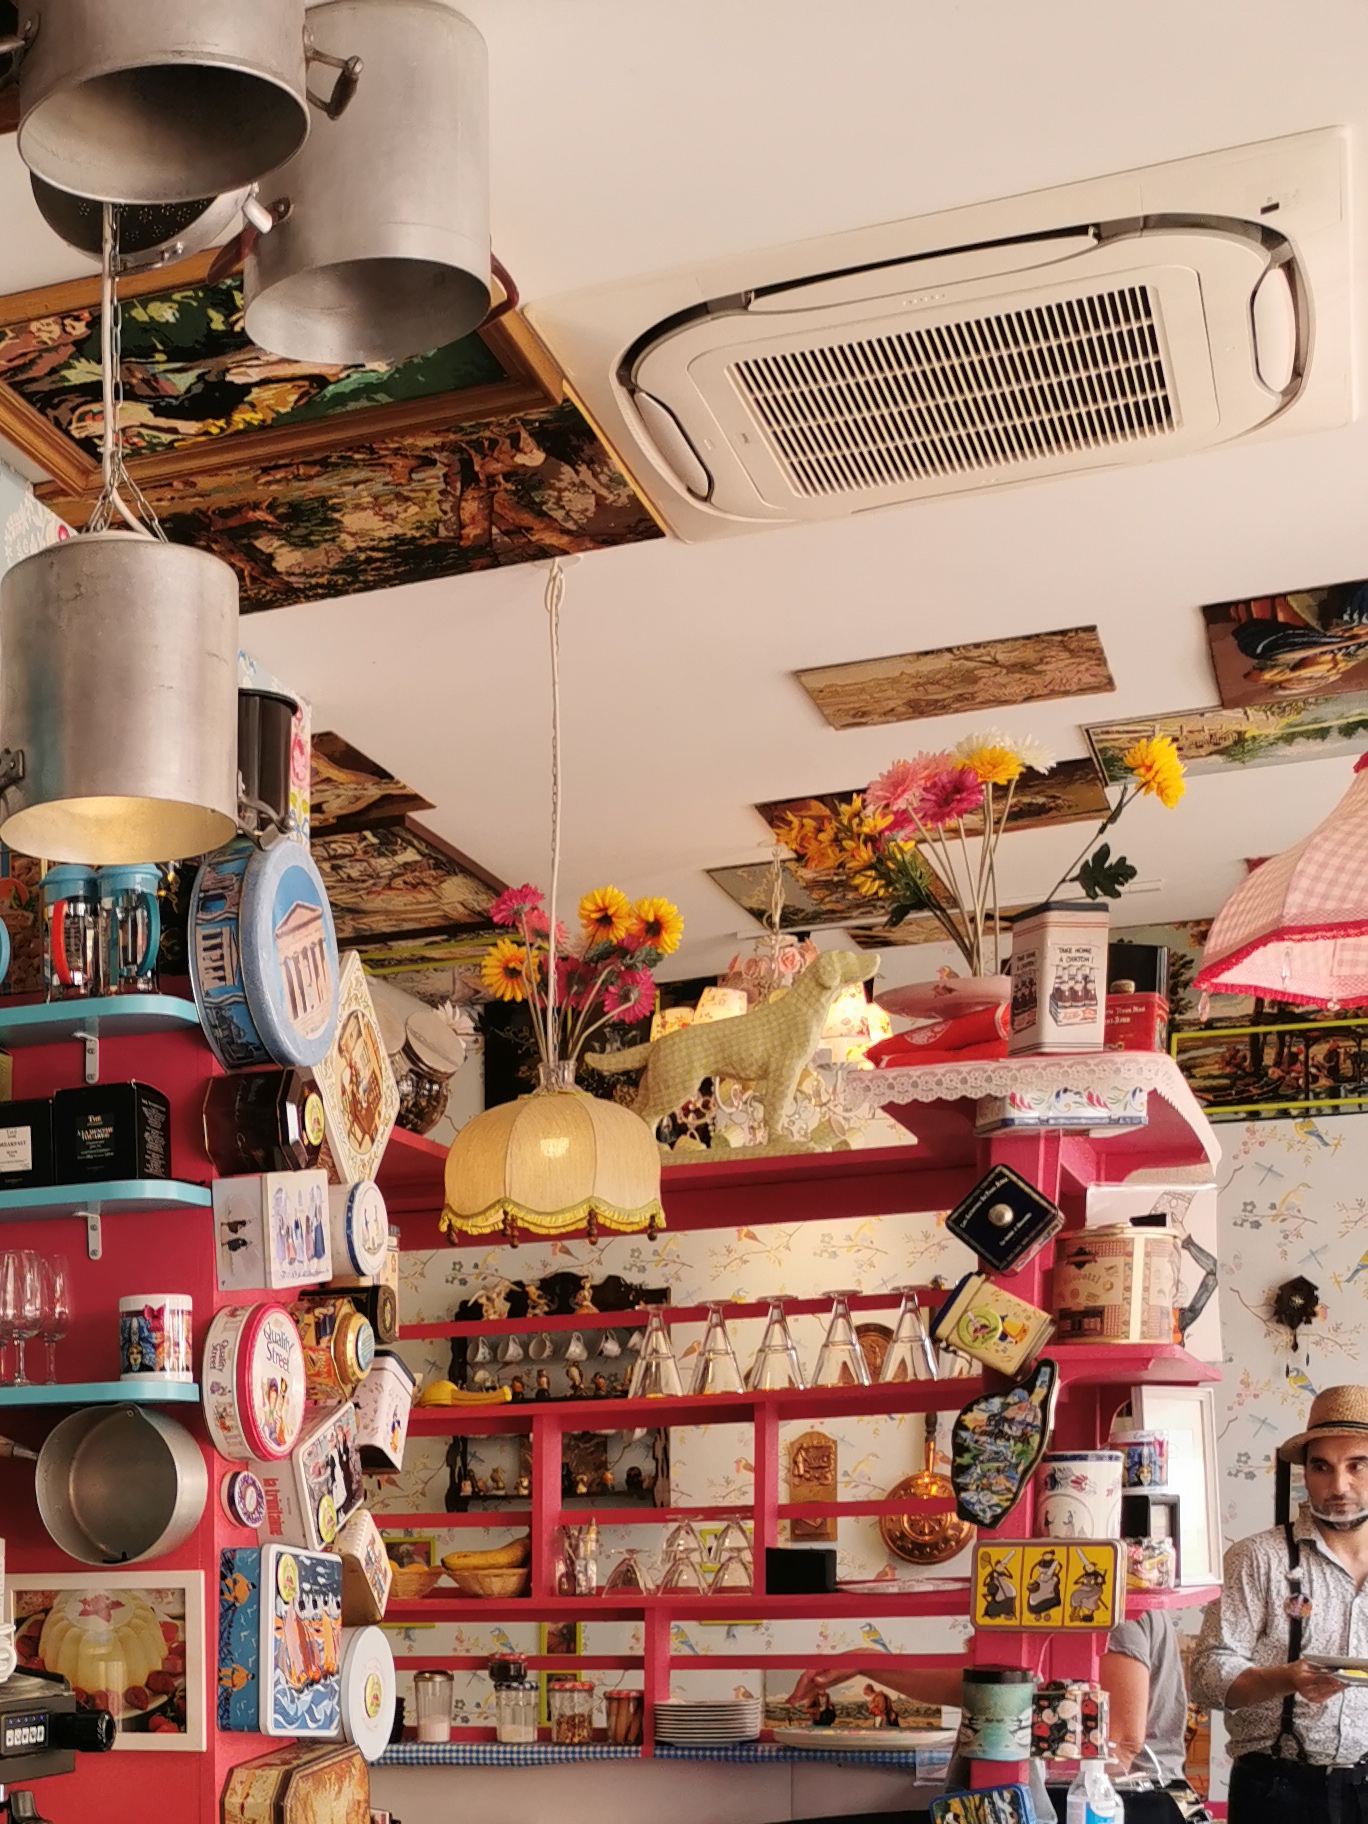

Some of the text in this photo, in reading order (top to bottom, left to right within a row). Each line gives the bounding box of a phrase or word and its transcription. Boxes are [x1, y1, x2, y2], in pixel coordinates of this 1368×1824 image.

[263, 1321, 295, 1354] Quality
[217, 1339, 229, 1373] Quality
[266, 1341, 291, 1374] Street
